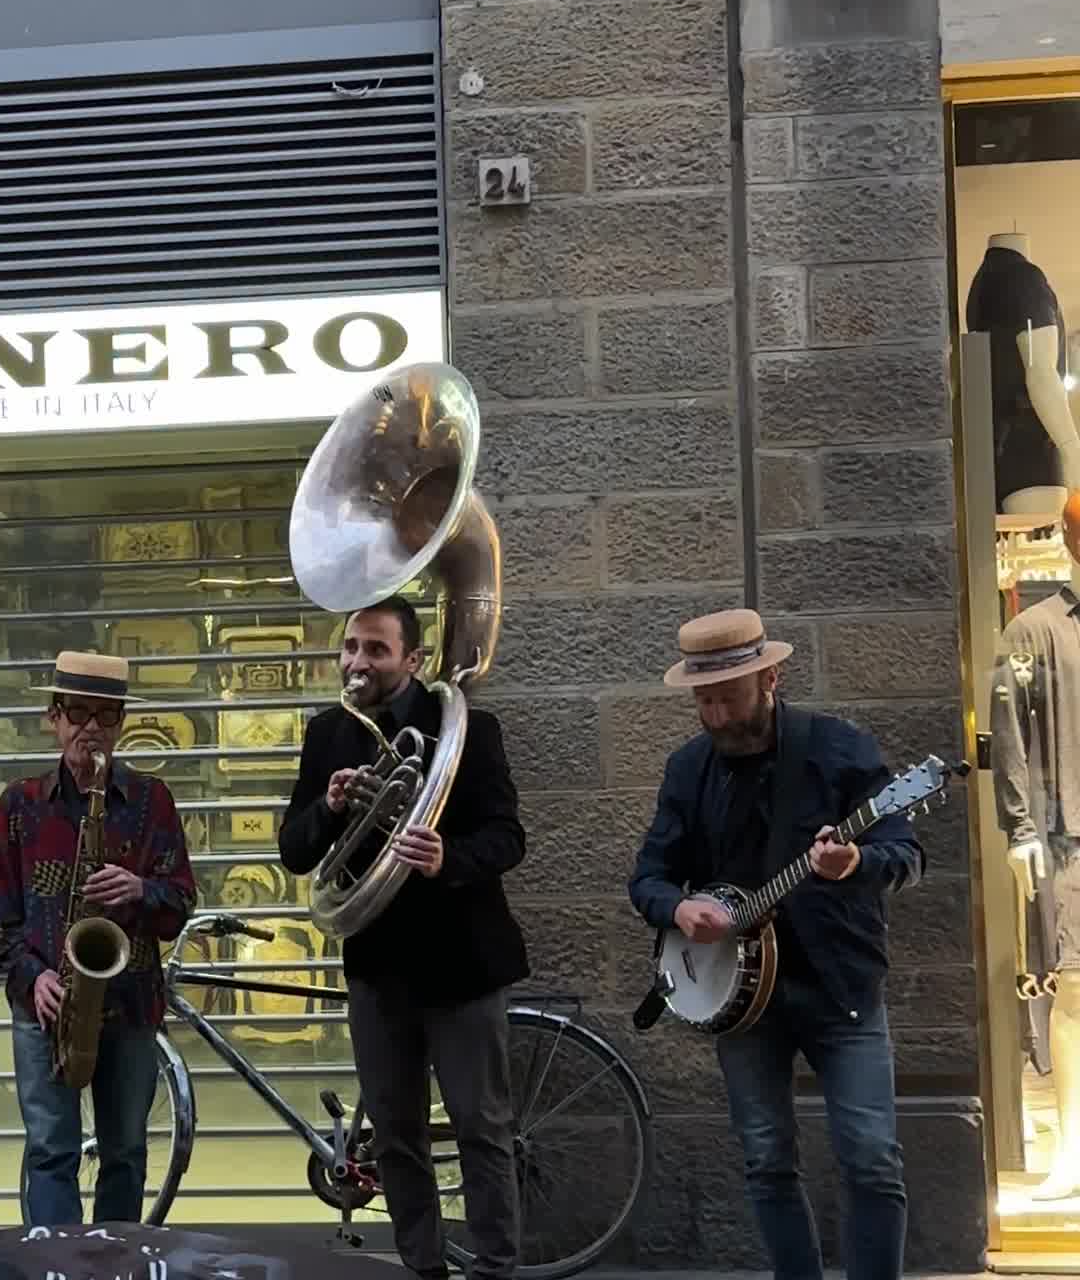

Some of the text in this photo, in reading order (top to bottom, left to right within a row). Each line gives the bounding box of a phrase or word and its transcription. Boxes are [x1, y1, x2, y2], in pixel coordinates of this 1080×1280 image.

[485, 166, 525, 198] 24
[34, 394, 62, 418] IN
[82, 388, 159, 416] ITALY
